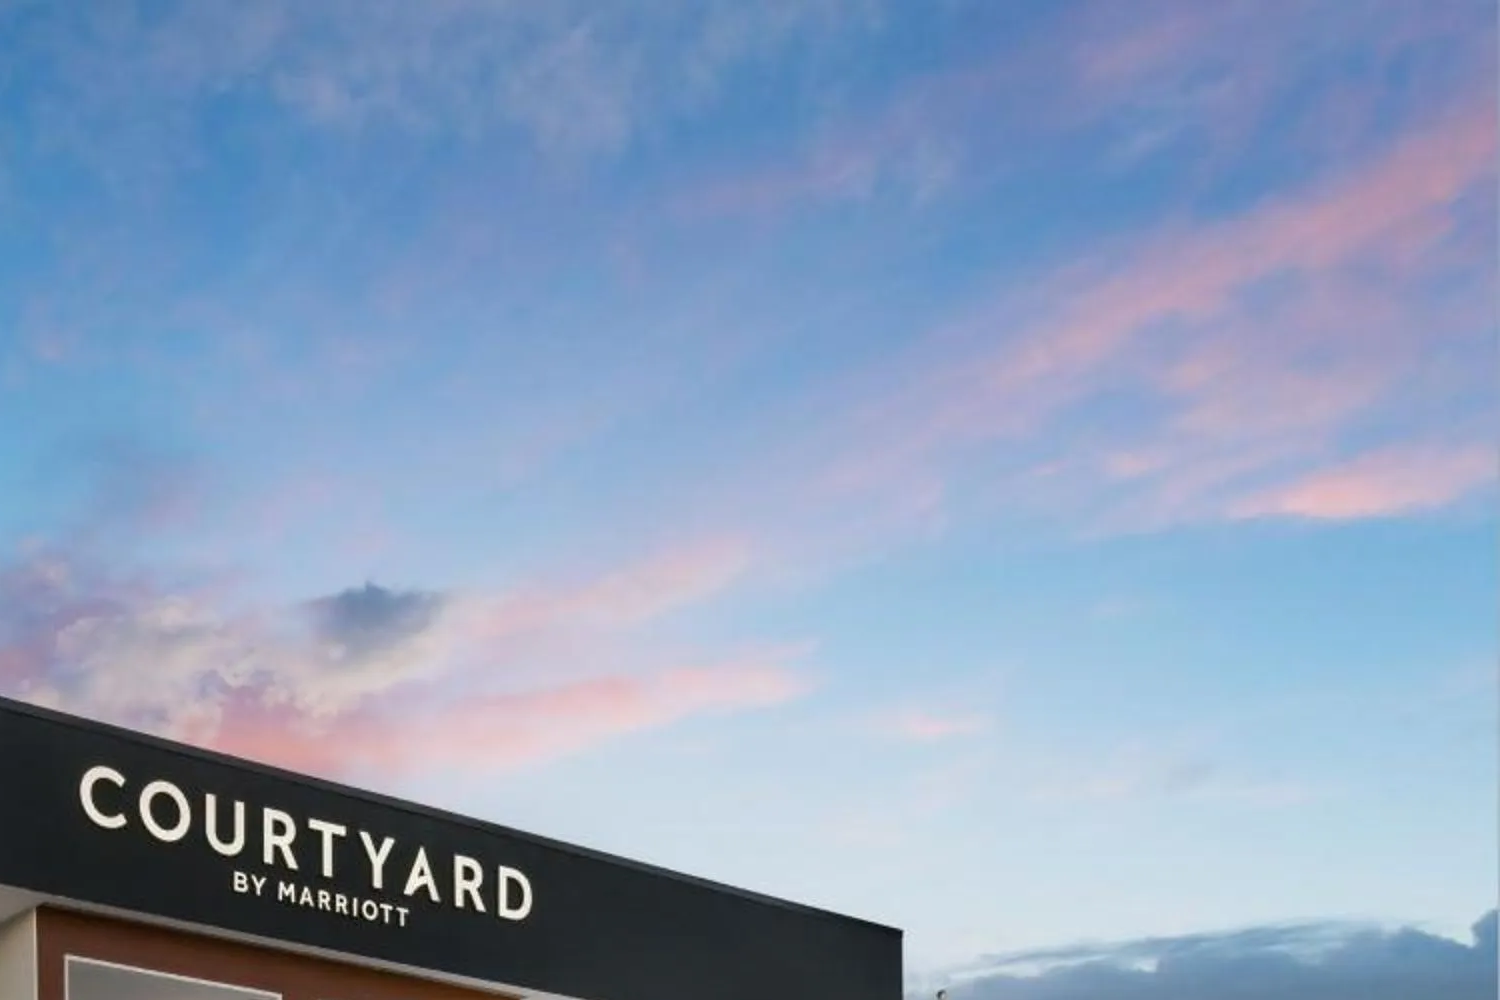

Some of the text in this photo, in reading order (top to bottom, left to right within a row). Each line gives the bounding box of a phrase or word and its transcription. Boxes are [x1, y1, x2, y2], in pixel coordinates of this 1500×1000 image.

[79, 765, 533, 921] COURTYARD
[233, 870, 410, 927] BY MARRIOTT
